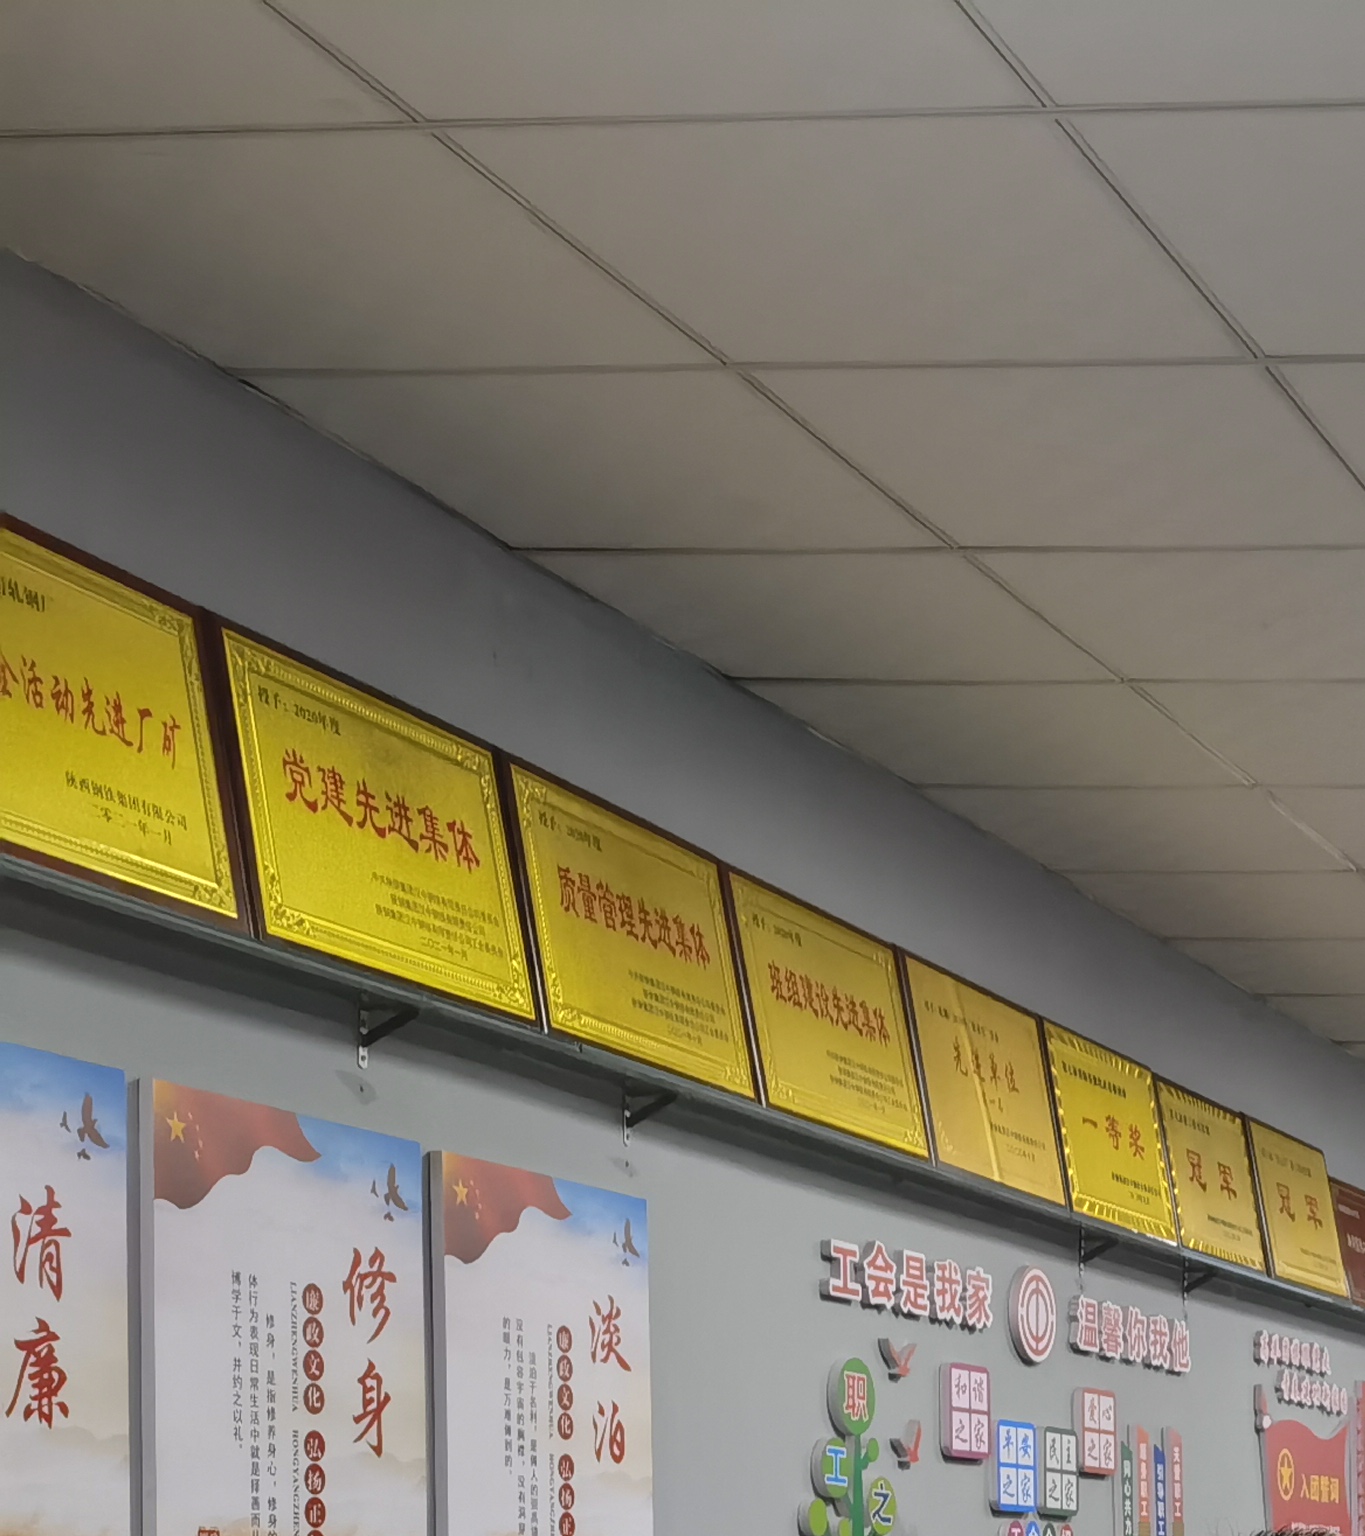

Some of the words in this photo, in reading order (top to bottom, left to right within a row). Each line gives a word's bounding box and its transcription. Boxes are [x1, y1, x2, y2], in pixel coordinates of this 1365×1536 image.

[284, 747, 481, 874] 党建先进集体
[556, 862, 712, 971] 质量管理先进集体
[767, 959, 891, 1049] 班组建设先进集体
[1082, 1114, 1146, 1162] 一等奖
[1185, 1147, 1237, 1200] 冠军
[5, 1184, 72, 1430] 清廉
[829, 1238, 992, 1328] 工会是我家
[1078, 1294, 1191, 1373] 温馨你我他
[303, 1285, 324, 1413] 廉政文化
[342, 1246, 398, 1459] 修身
[588, 1294, 632, 1465] 淡泊
